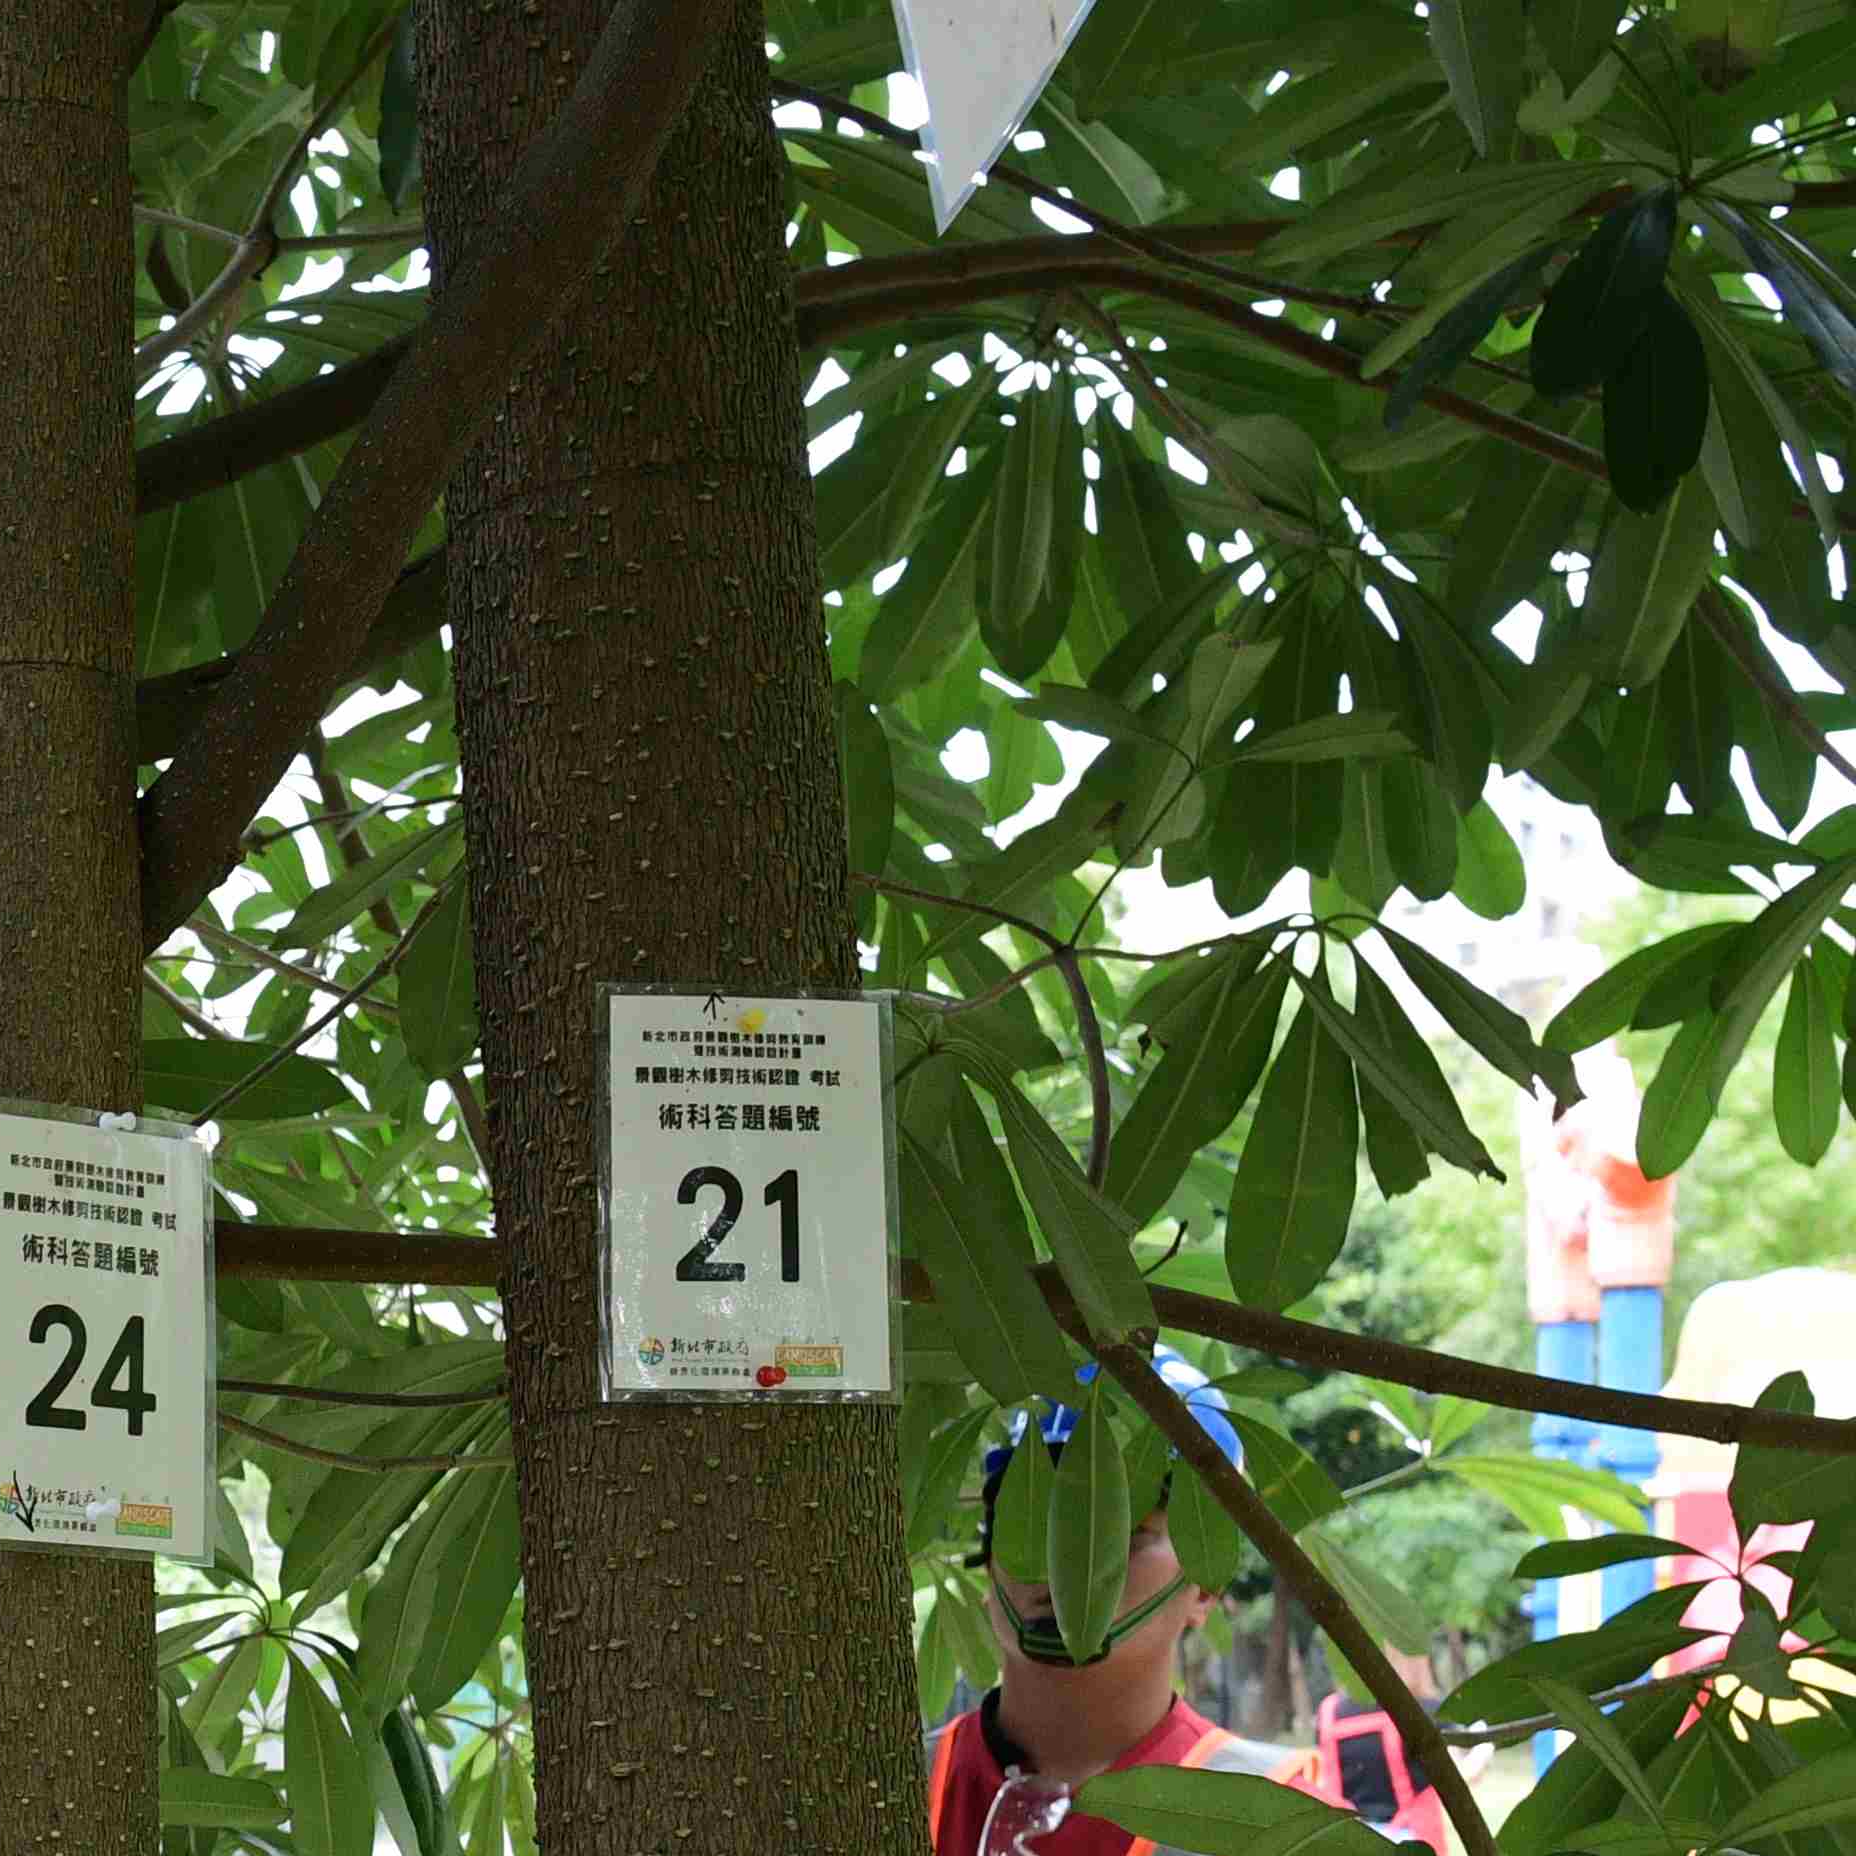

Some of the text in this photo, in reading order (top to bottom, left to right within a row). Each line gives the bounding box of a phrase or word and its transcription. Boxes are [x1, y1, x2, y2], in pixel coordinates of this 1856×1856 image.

[636, 1067, 840, 1087] 景觀樹木修剪技術認證 考試
[659, 1104, 820, 1131] 術科答題編號
[3, 1192, 177, 1231] 景觀樹木修剪技術認證 考試
[675, 1166, 800, 1282] 21
[22, 1234, 159, 1277] 術科答題編號
[25, 1303, 156, 1436] 24
